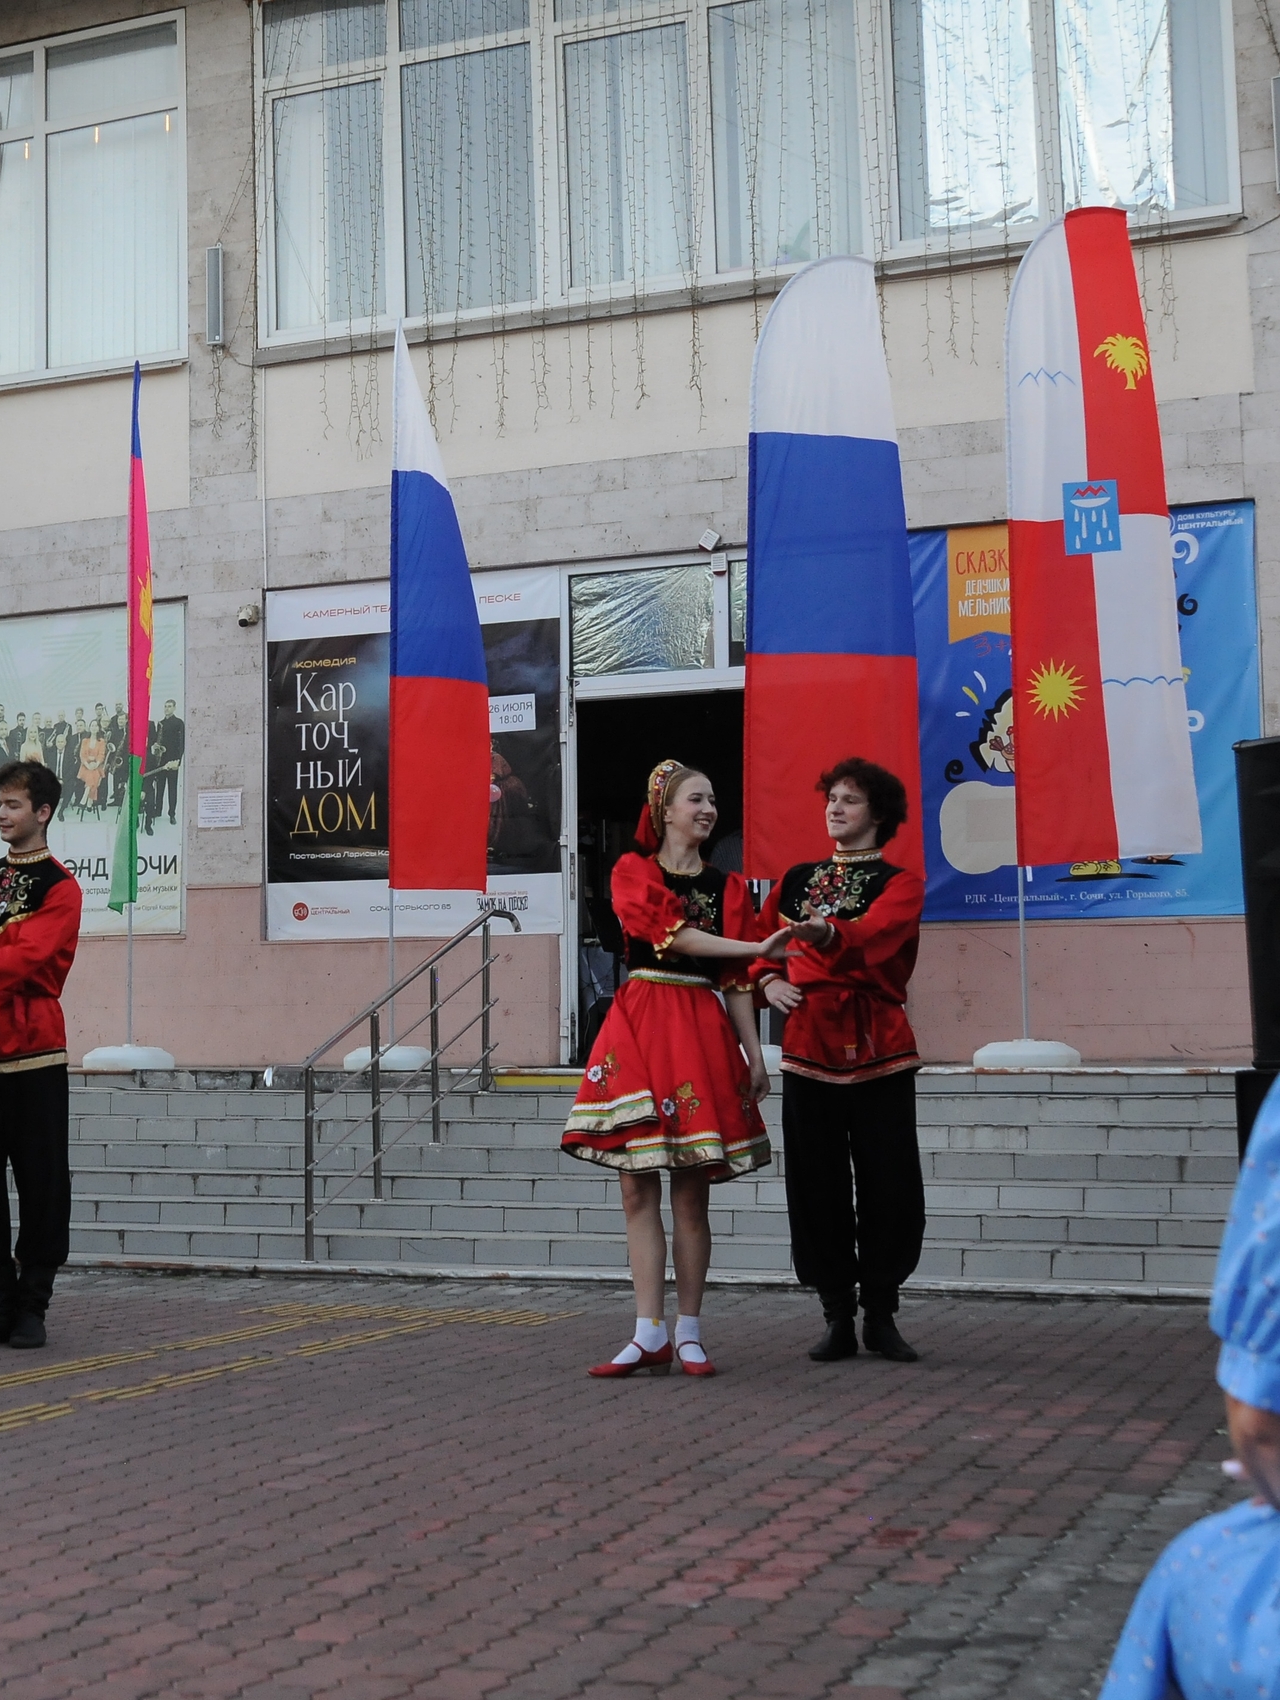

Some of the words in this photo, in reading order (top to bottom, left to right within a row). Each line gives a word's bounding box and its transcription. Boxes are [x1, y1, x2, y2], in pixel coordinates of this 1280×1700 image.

[1177, 513, 1195, 521] ДОМ
[1196, 510, 1236, 519] КУЛЬТУРЫ
[1178, 518, 1244, 530] ЦЕНТРАЛЬНЫЙ
[955, 549, 1009, 575] СКАЗК
[965, 577, 1010, 596] ДЕДУШКИ
[479, 593, 521, 604] ПЕСКЕ
[303, 605, 371, 619] КАМЕРНЫЙ
[958, 597, 1011, 617] МЕЛЬНИК
[296, 672, 357, 723] Кар
[488, 704, 500, 714] 26
[502, 701, 533, 712] ИЮЛЯ
[499, 714, 524, 724] 18:00
[289, 852, 342, 860] Постановка
[343, 850, 377, 858] Ларисы
[63, 858, 109, 880] ЭНД
[137, 854, 178, 875] ОЧИ
[965, 894, 987, 904] РДК
[989, 893, 1067, 904] «Центальный»,
[394, 903, 440, 911] ГОРЬКОГО
